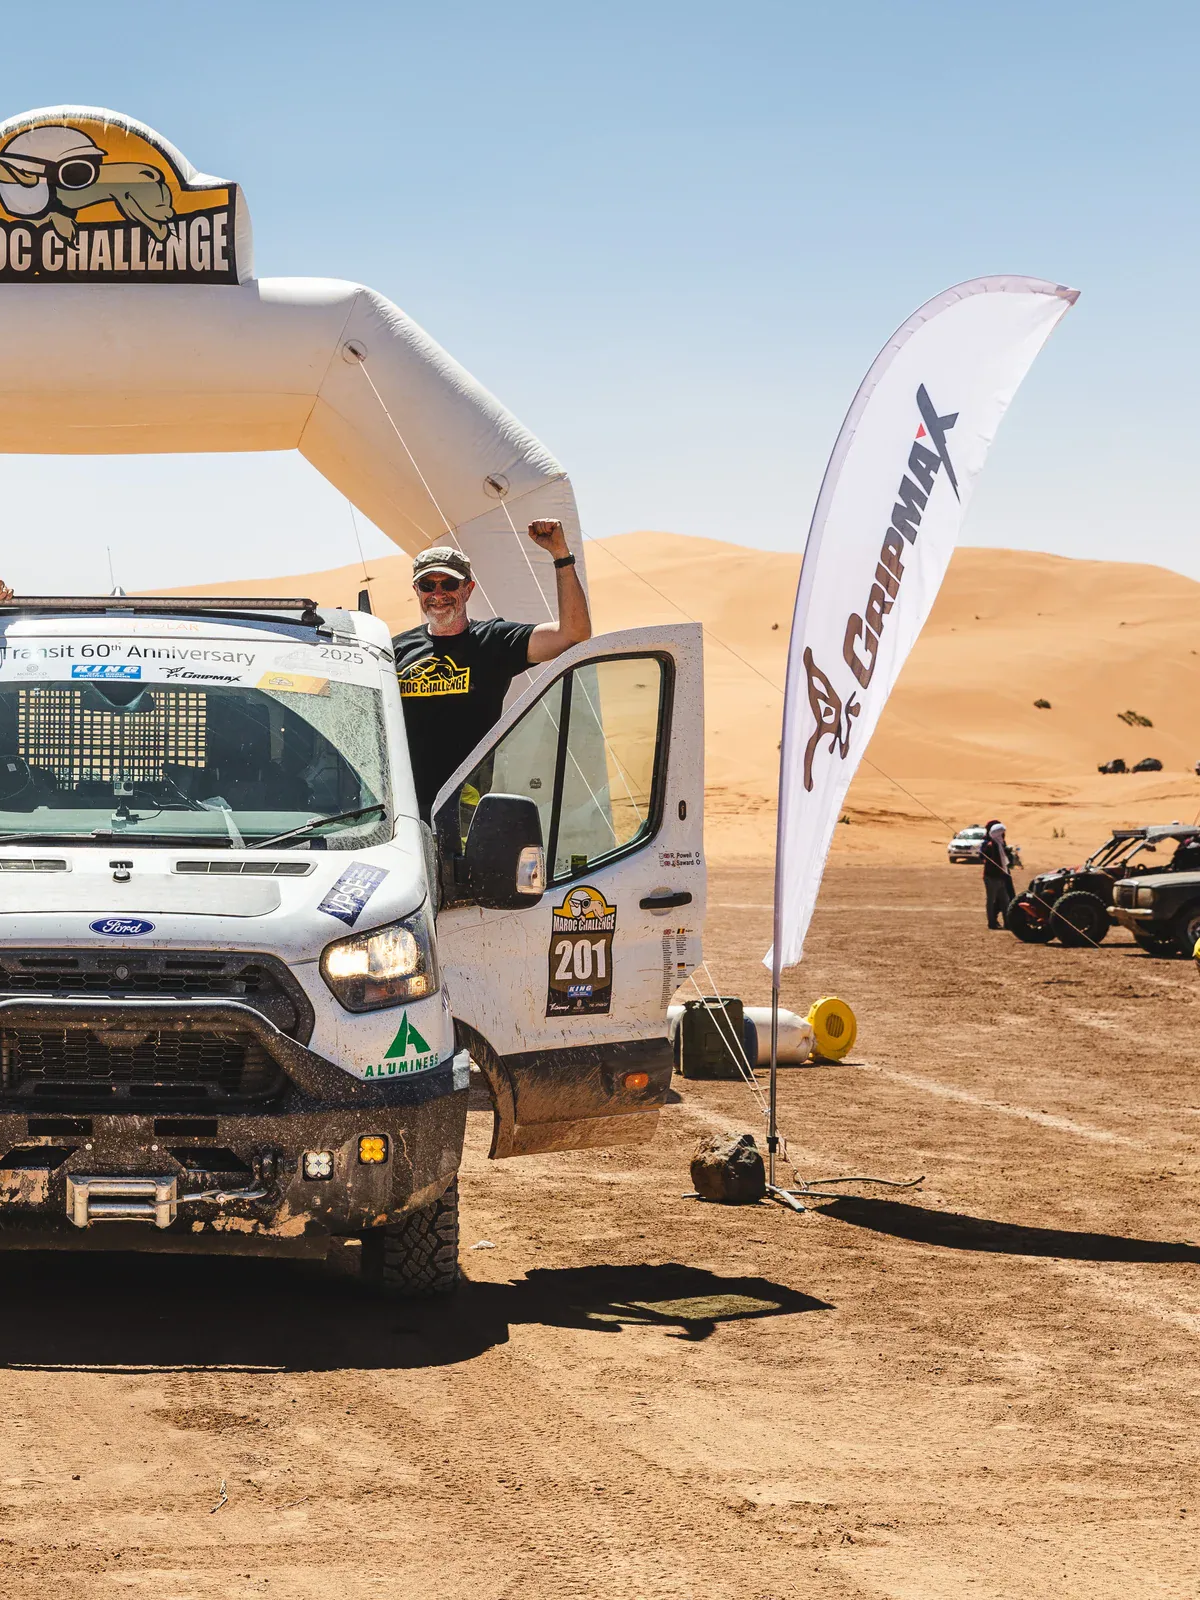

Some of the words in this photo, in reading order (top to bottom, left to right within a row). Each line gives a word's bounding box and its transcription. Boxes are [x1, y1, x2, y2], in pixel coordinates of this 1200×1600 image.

[41, 211, 230, 271] CHALLENGE
[842, 382, 961, 690] GRIPMAX
[81, 644, 121, 658] 60th
[127, 646, 256, 666] Anniversary
[320, 648, 363, 664] 2025
[73, 665, 139, 673] KING
[181, 671, 243, 684] GRIPMAX
[400, 681, 418, 693] ROC
[102, 919, 142, 933] Ford
[553, 915, 577, 932] MAROC
[578, 914, 615, 931] CHALLENGE
[555, 939, 606, 980] 201
[365, 1053, 438, 1077] ALUMINESS
